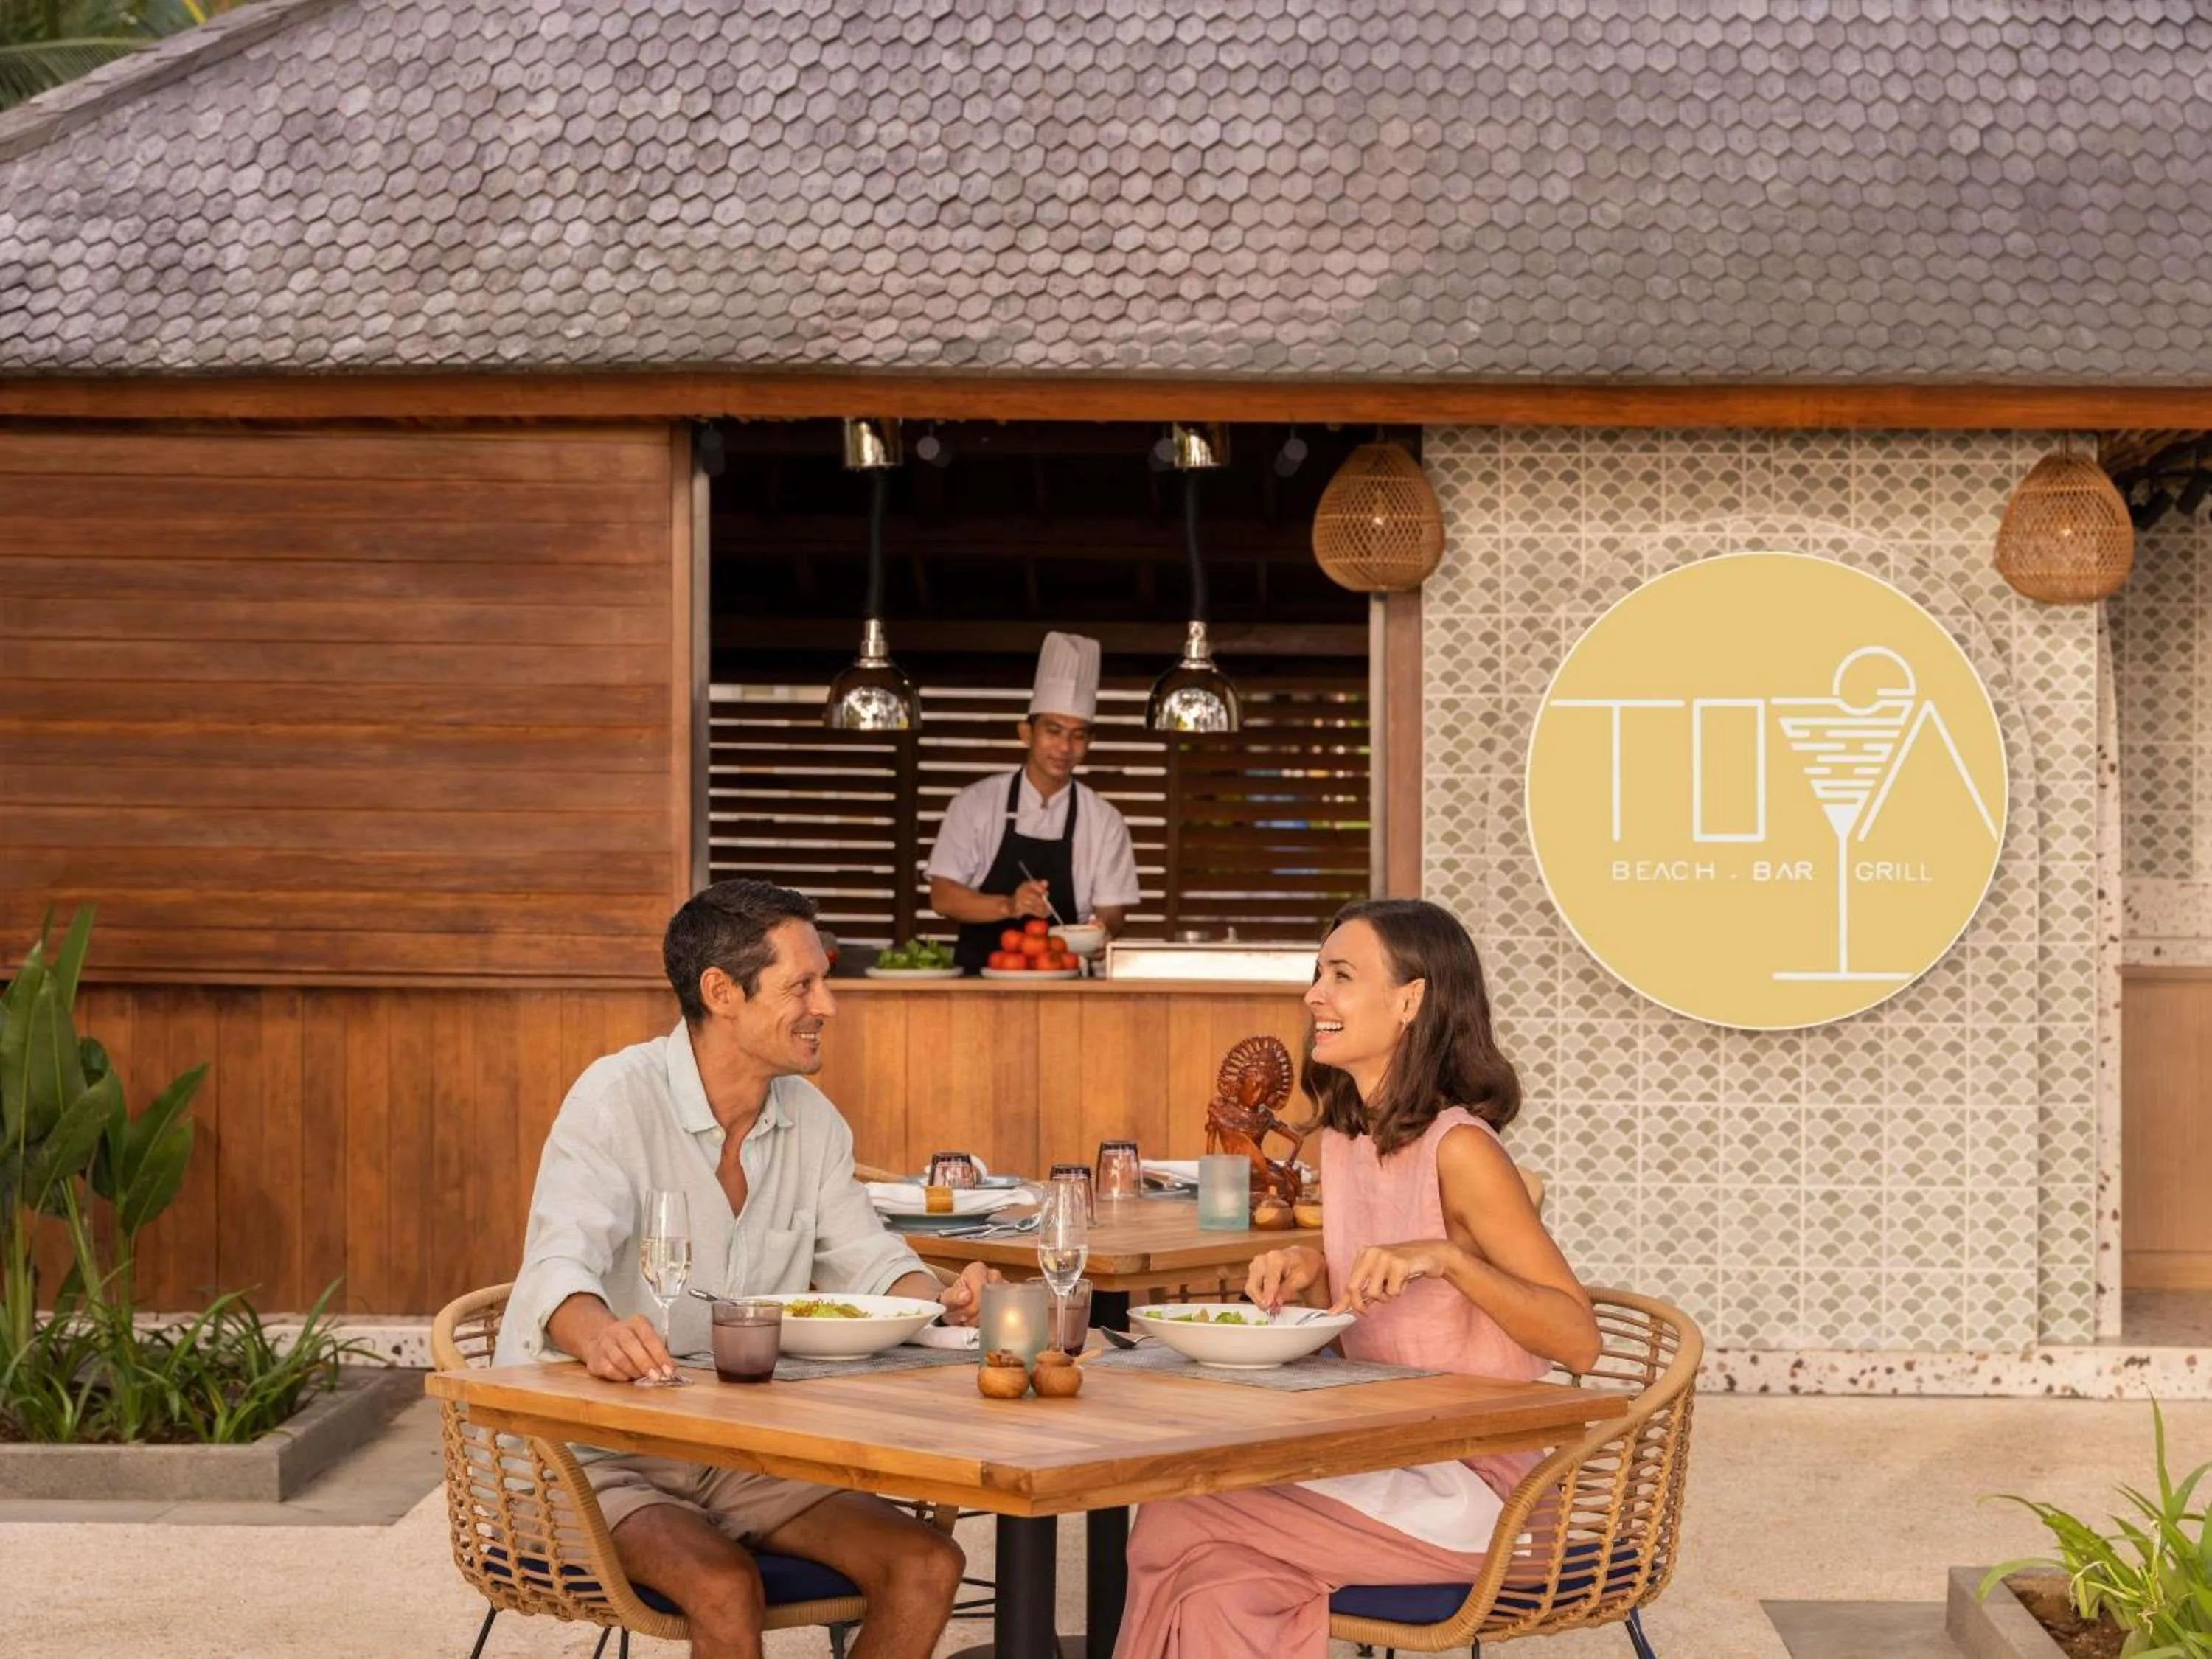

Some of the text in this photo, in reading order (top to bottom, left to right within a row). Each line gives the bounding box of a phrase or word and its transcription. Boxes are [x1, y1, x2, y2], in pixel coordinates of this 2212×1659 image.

[1612, 860, 1933, 881] BEACH BAR GRILL
